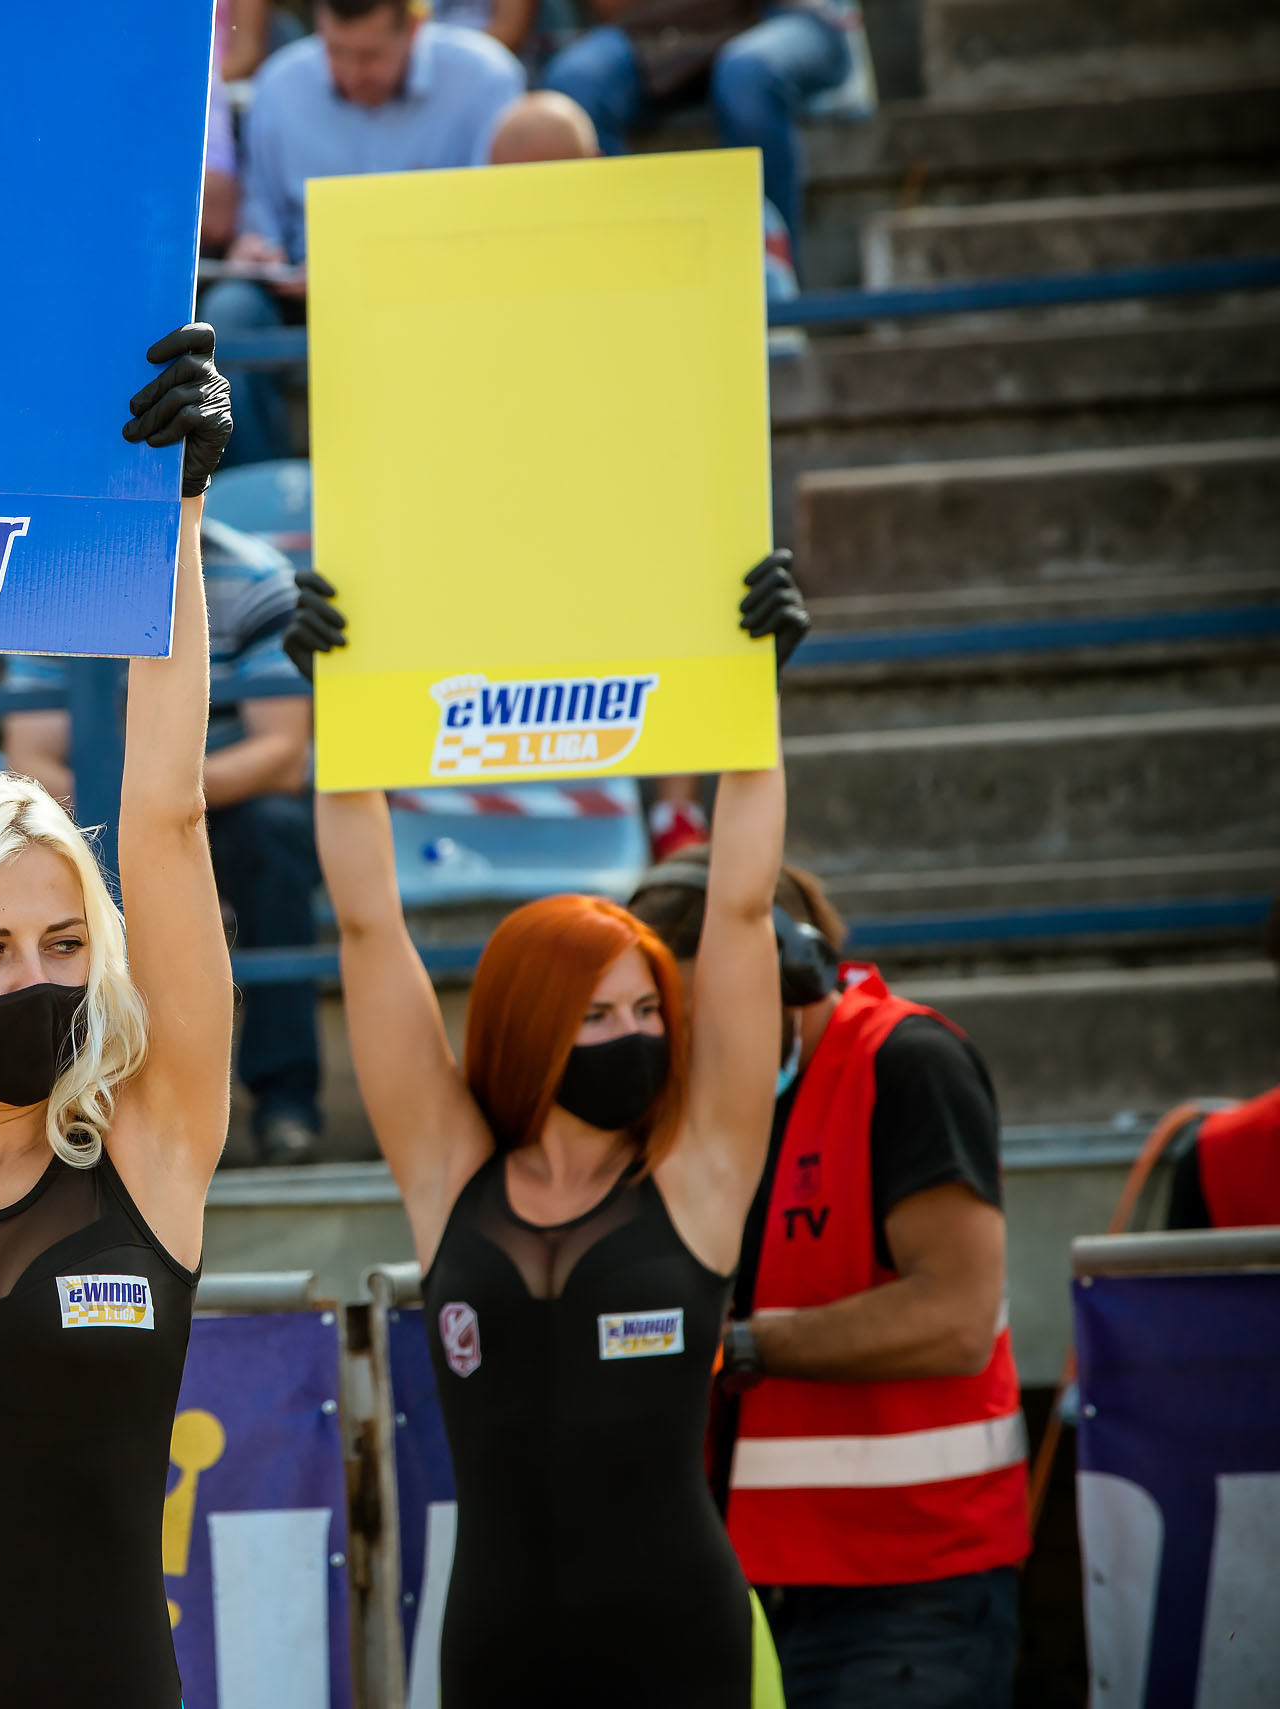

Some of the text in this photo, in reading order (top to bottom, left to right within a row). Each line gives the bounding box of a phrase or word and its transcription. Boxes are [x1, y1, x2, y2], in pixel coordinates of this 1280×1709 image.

[518, 733, 599, 762] 1. LIGA
[783, 1206, 830, 1240] TV
[114, 1307, 136, 1321] LIGA
